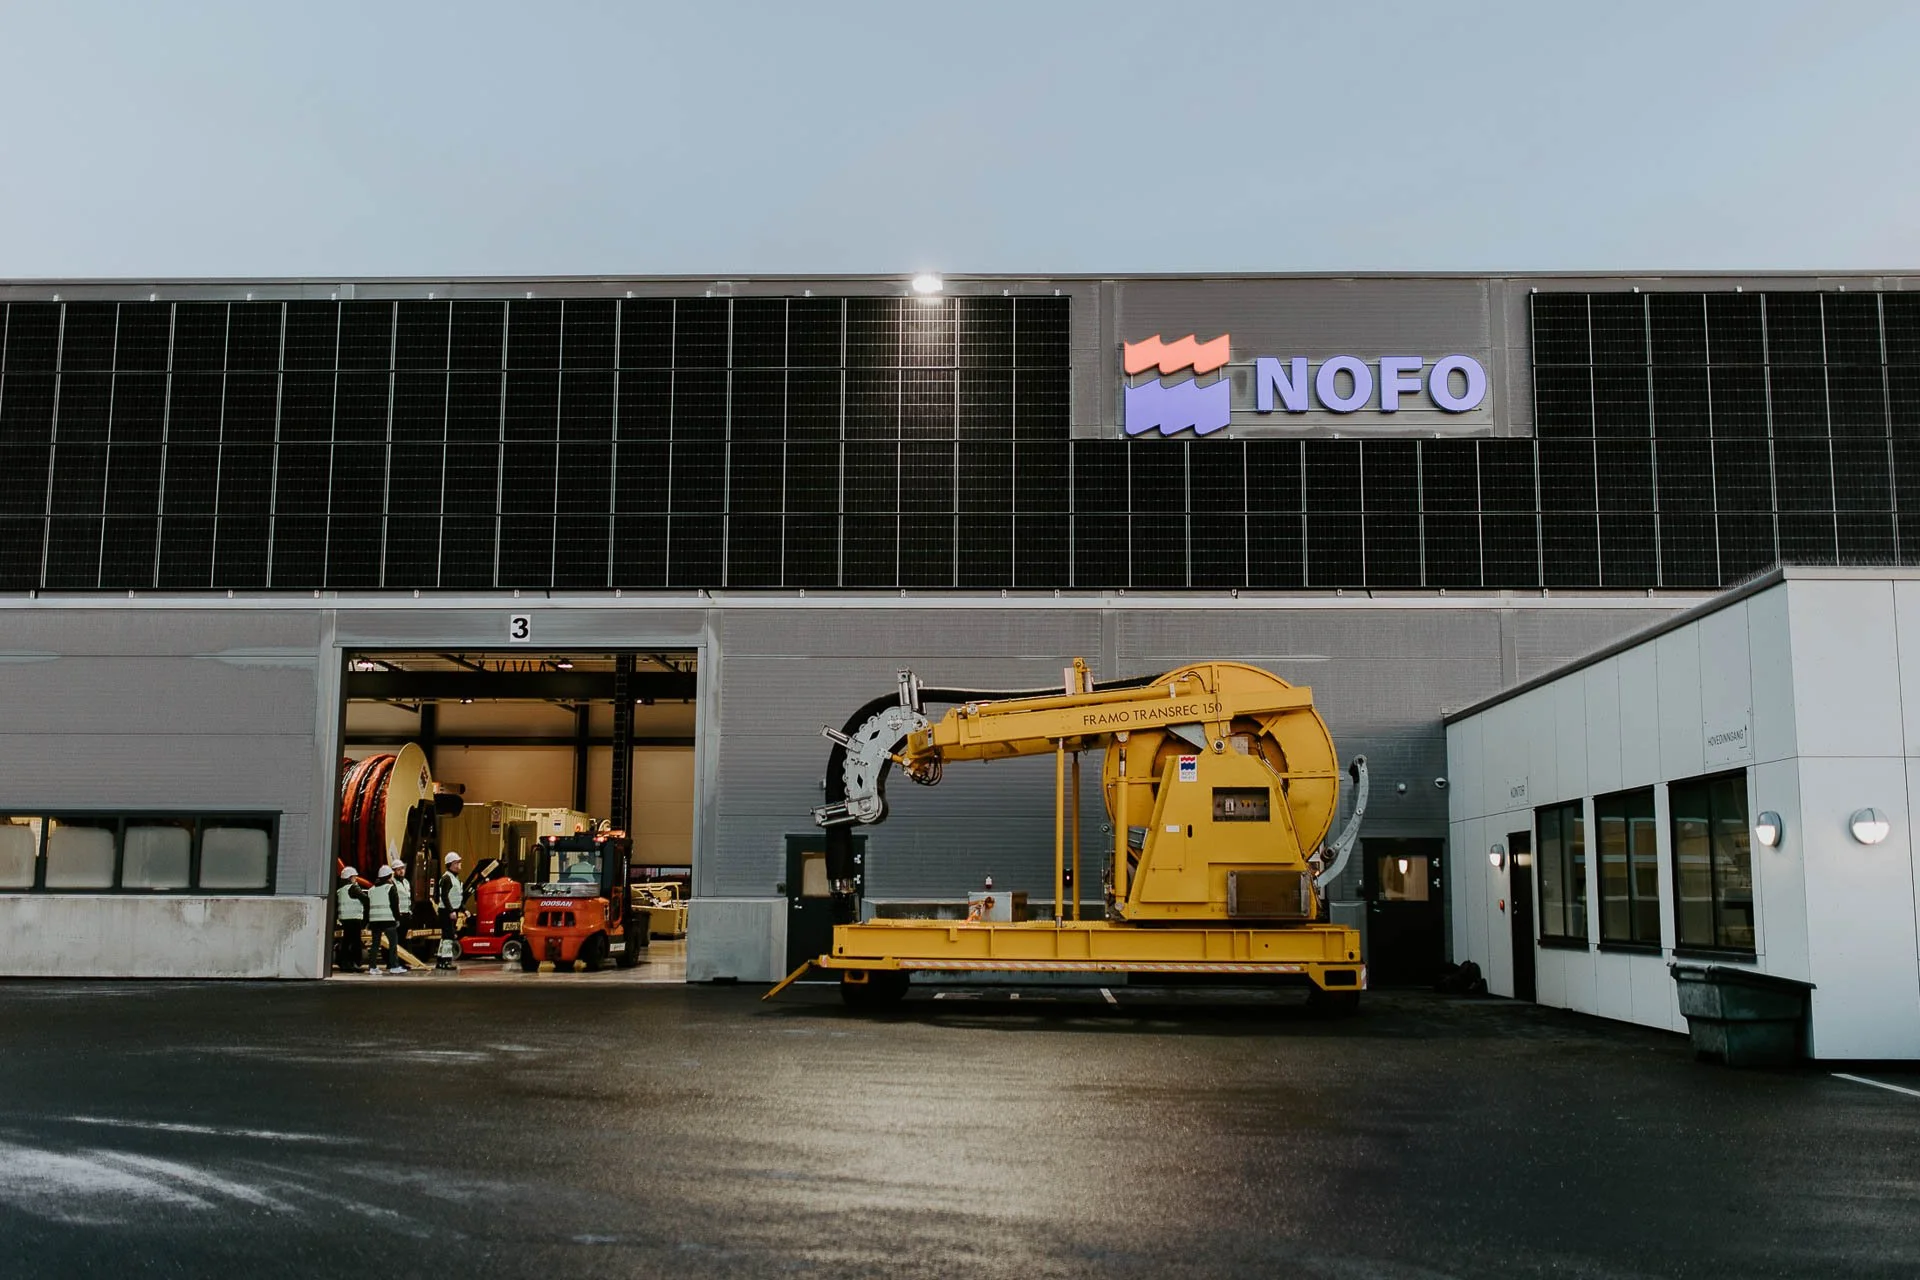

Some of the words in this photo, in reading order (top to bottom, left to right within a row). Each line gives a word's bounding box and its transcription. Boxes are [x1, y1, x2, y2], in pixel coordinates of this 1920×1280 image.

[1256, 354, 1487, 413] NOFO
[512, 617, 529, 639] 3
[1083, 711, 1130, 726] FRAMO
[1133, 704, 1199, 721] TRANSREC
[1203, 702, 1223, 714] 150
[1708, 729, 1744, 746] HOVEDINNGANG
[540, 900, 573, 908] DOOSAN
